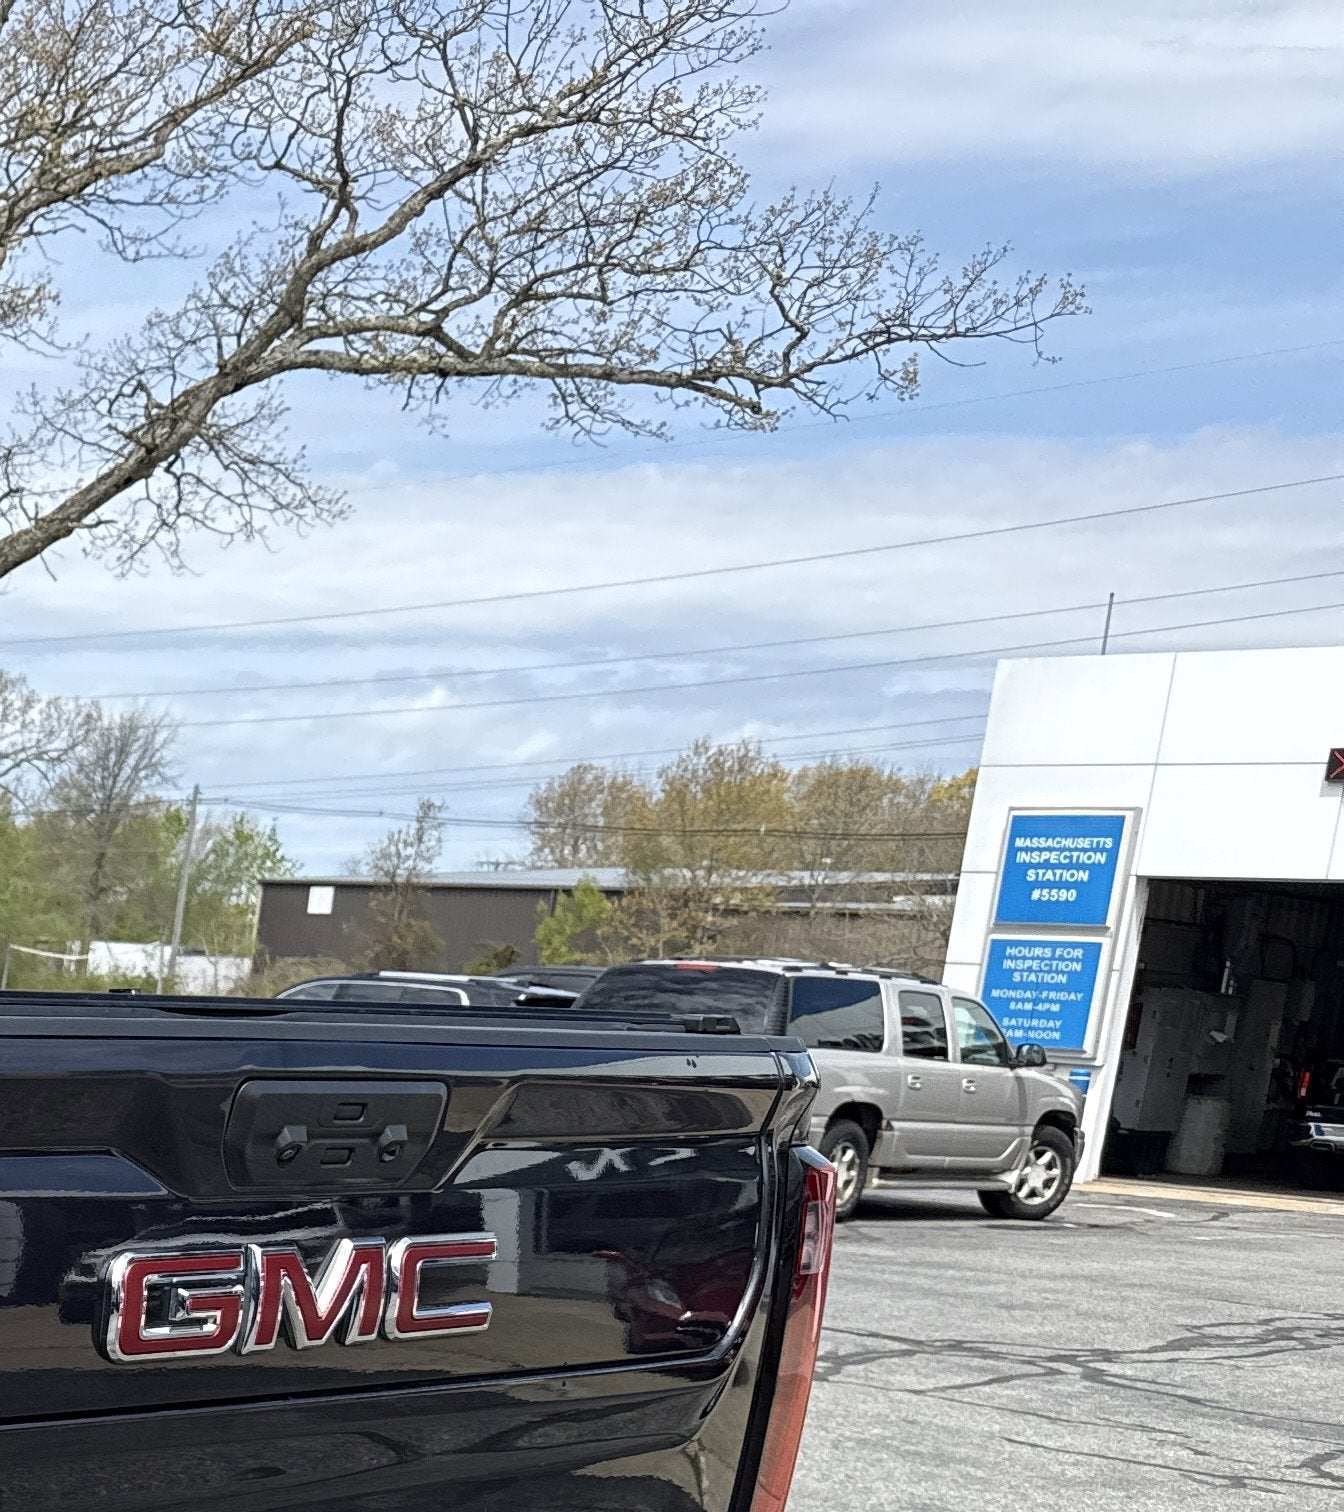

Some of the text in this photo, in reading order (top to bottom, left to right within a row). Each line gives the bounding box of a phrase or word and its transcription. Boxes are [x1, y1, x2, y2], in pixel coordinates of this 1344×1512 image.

[1014, 837, 1113, 849] MASSACHUSETTS
[1015, 851, 1107, 864] INSPECTION
[1025, 868, 1089, 882] STATION
[1030, 888, 1077, 901] #5590
[1005, 946, 1084, 959] HOURS FOR
[1002, 959, 1082, 972] INSPECTION
[1012, 971, 1067, 984] STATION
[991, 988, 1084, 1001] MONDAY-FRIDAY
[1002, 1017, 1063, 1029] SATURDAY
[101, 1232, 498, 1362] GMC
